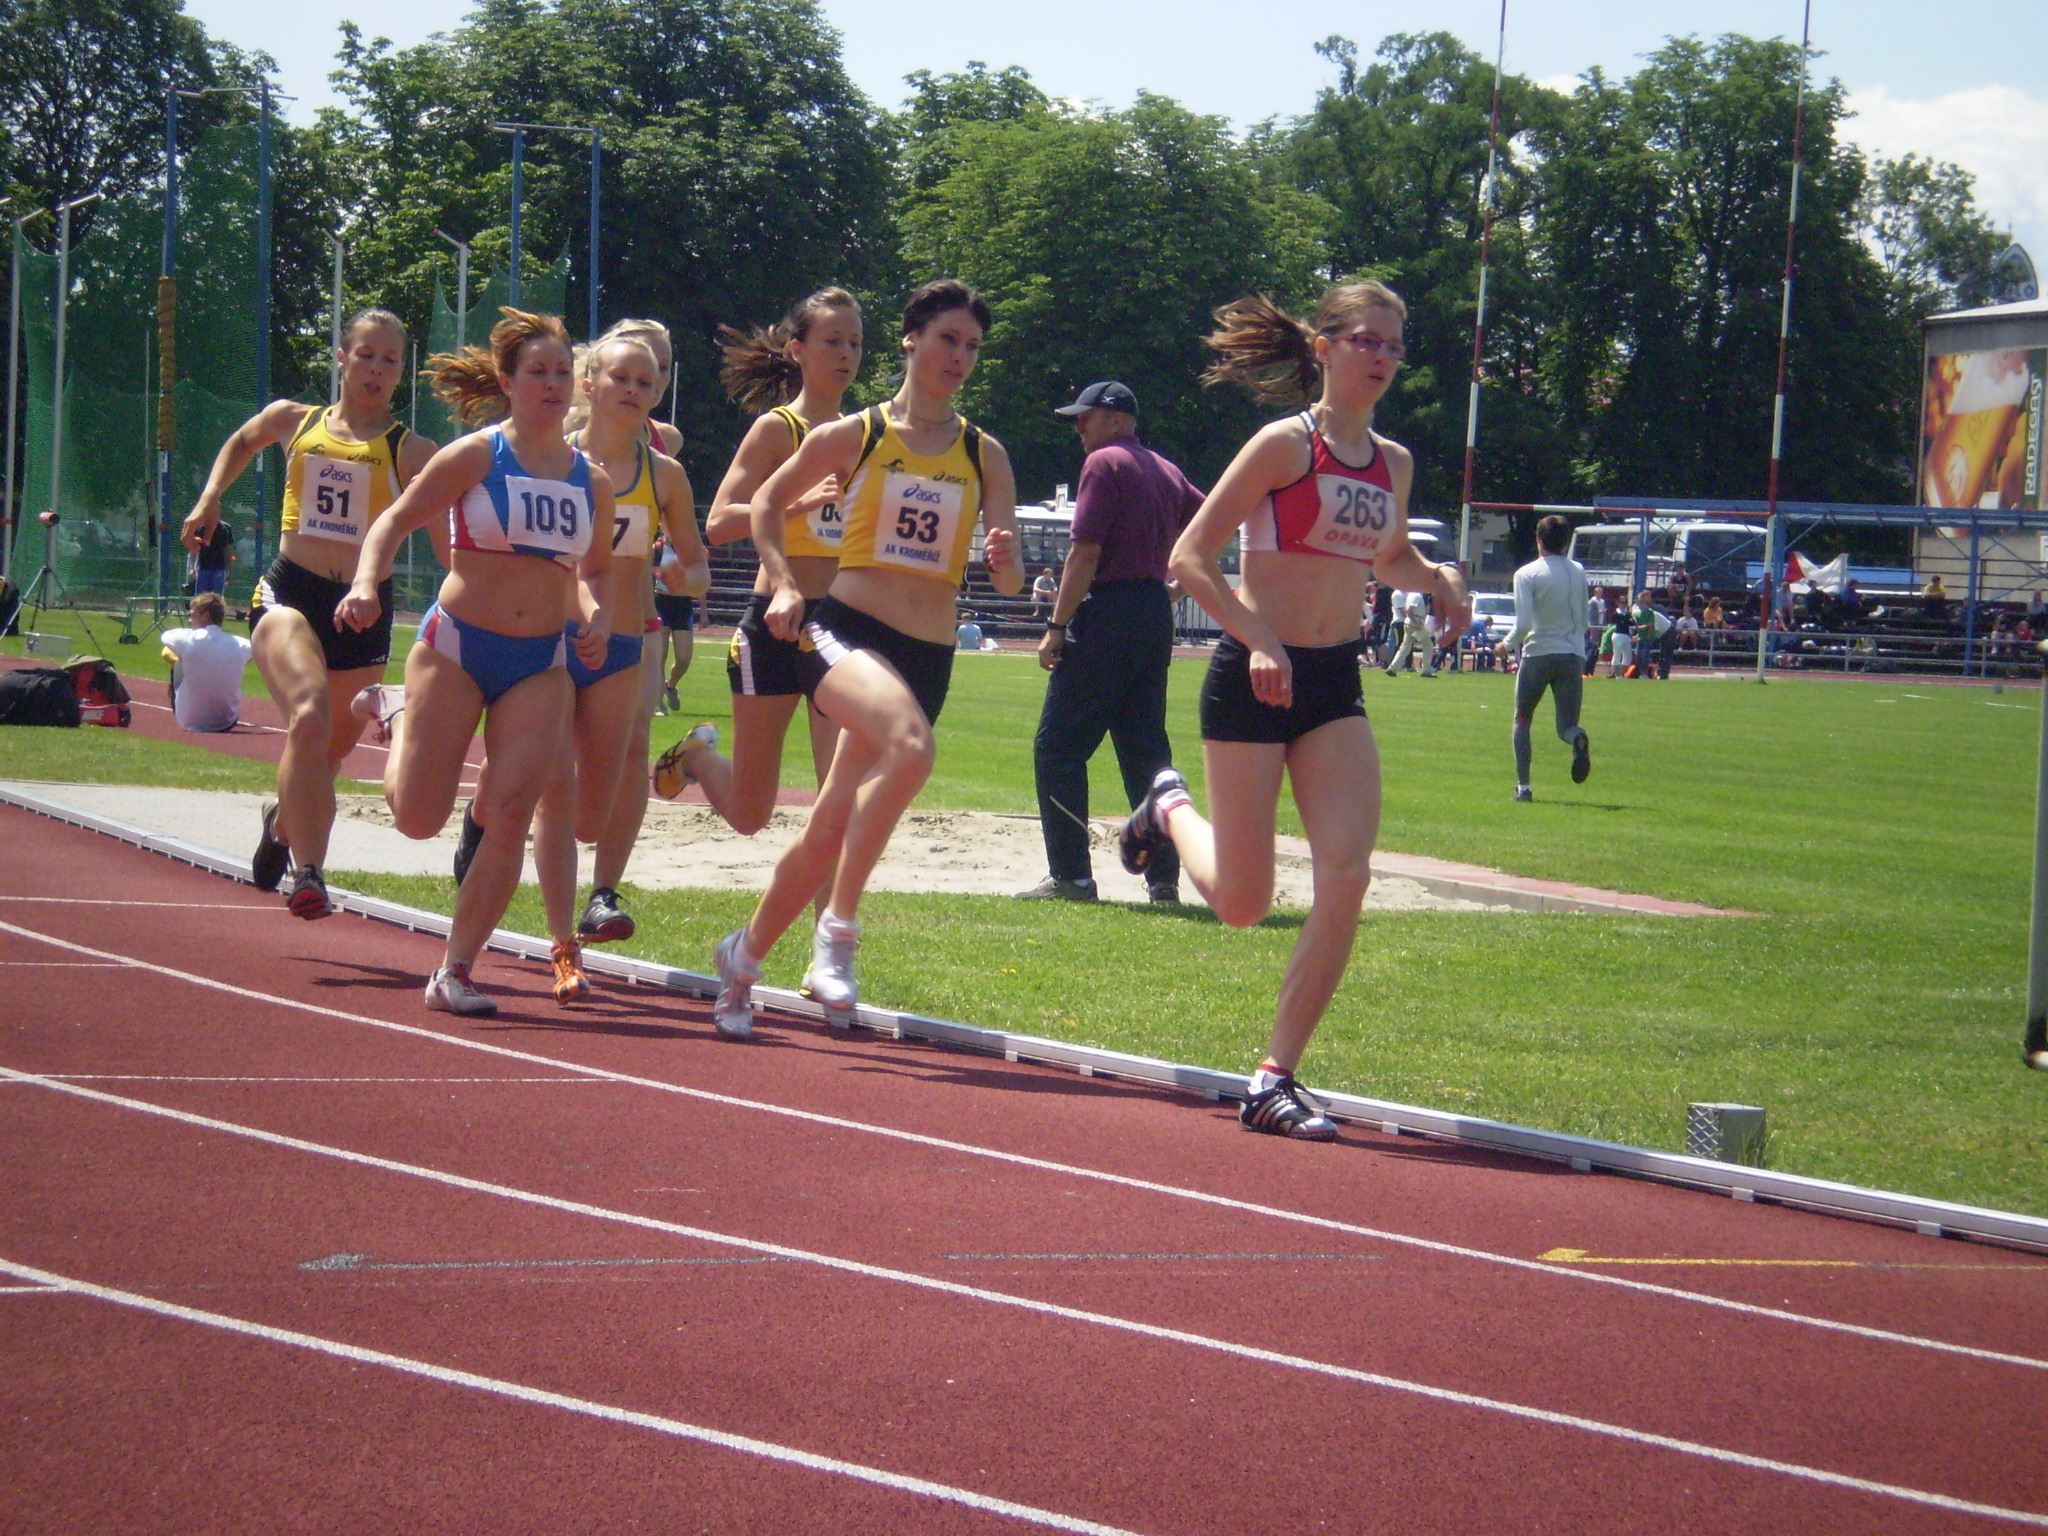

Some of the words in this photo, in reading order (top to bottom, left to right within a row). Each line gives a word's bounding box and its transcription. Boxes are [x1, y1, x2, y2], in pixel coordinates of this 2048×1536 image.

[2024, 374, 2043, 495] RADEGAST
[316, 485, 350, 518] 51
[521, 492, 578, 540] 109
[1334, 484, 1386, 531] 263
[307, 519, 317, 528] AK
[895, 506, 940, 544] 53
[1324, 529, 1379, 549] OPAVA
[885, 543, 896, 554] AK
